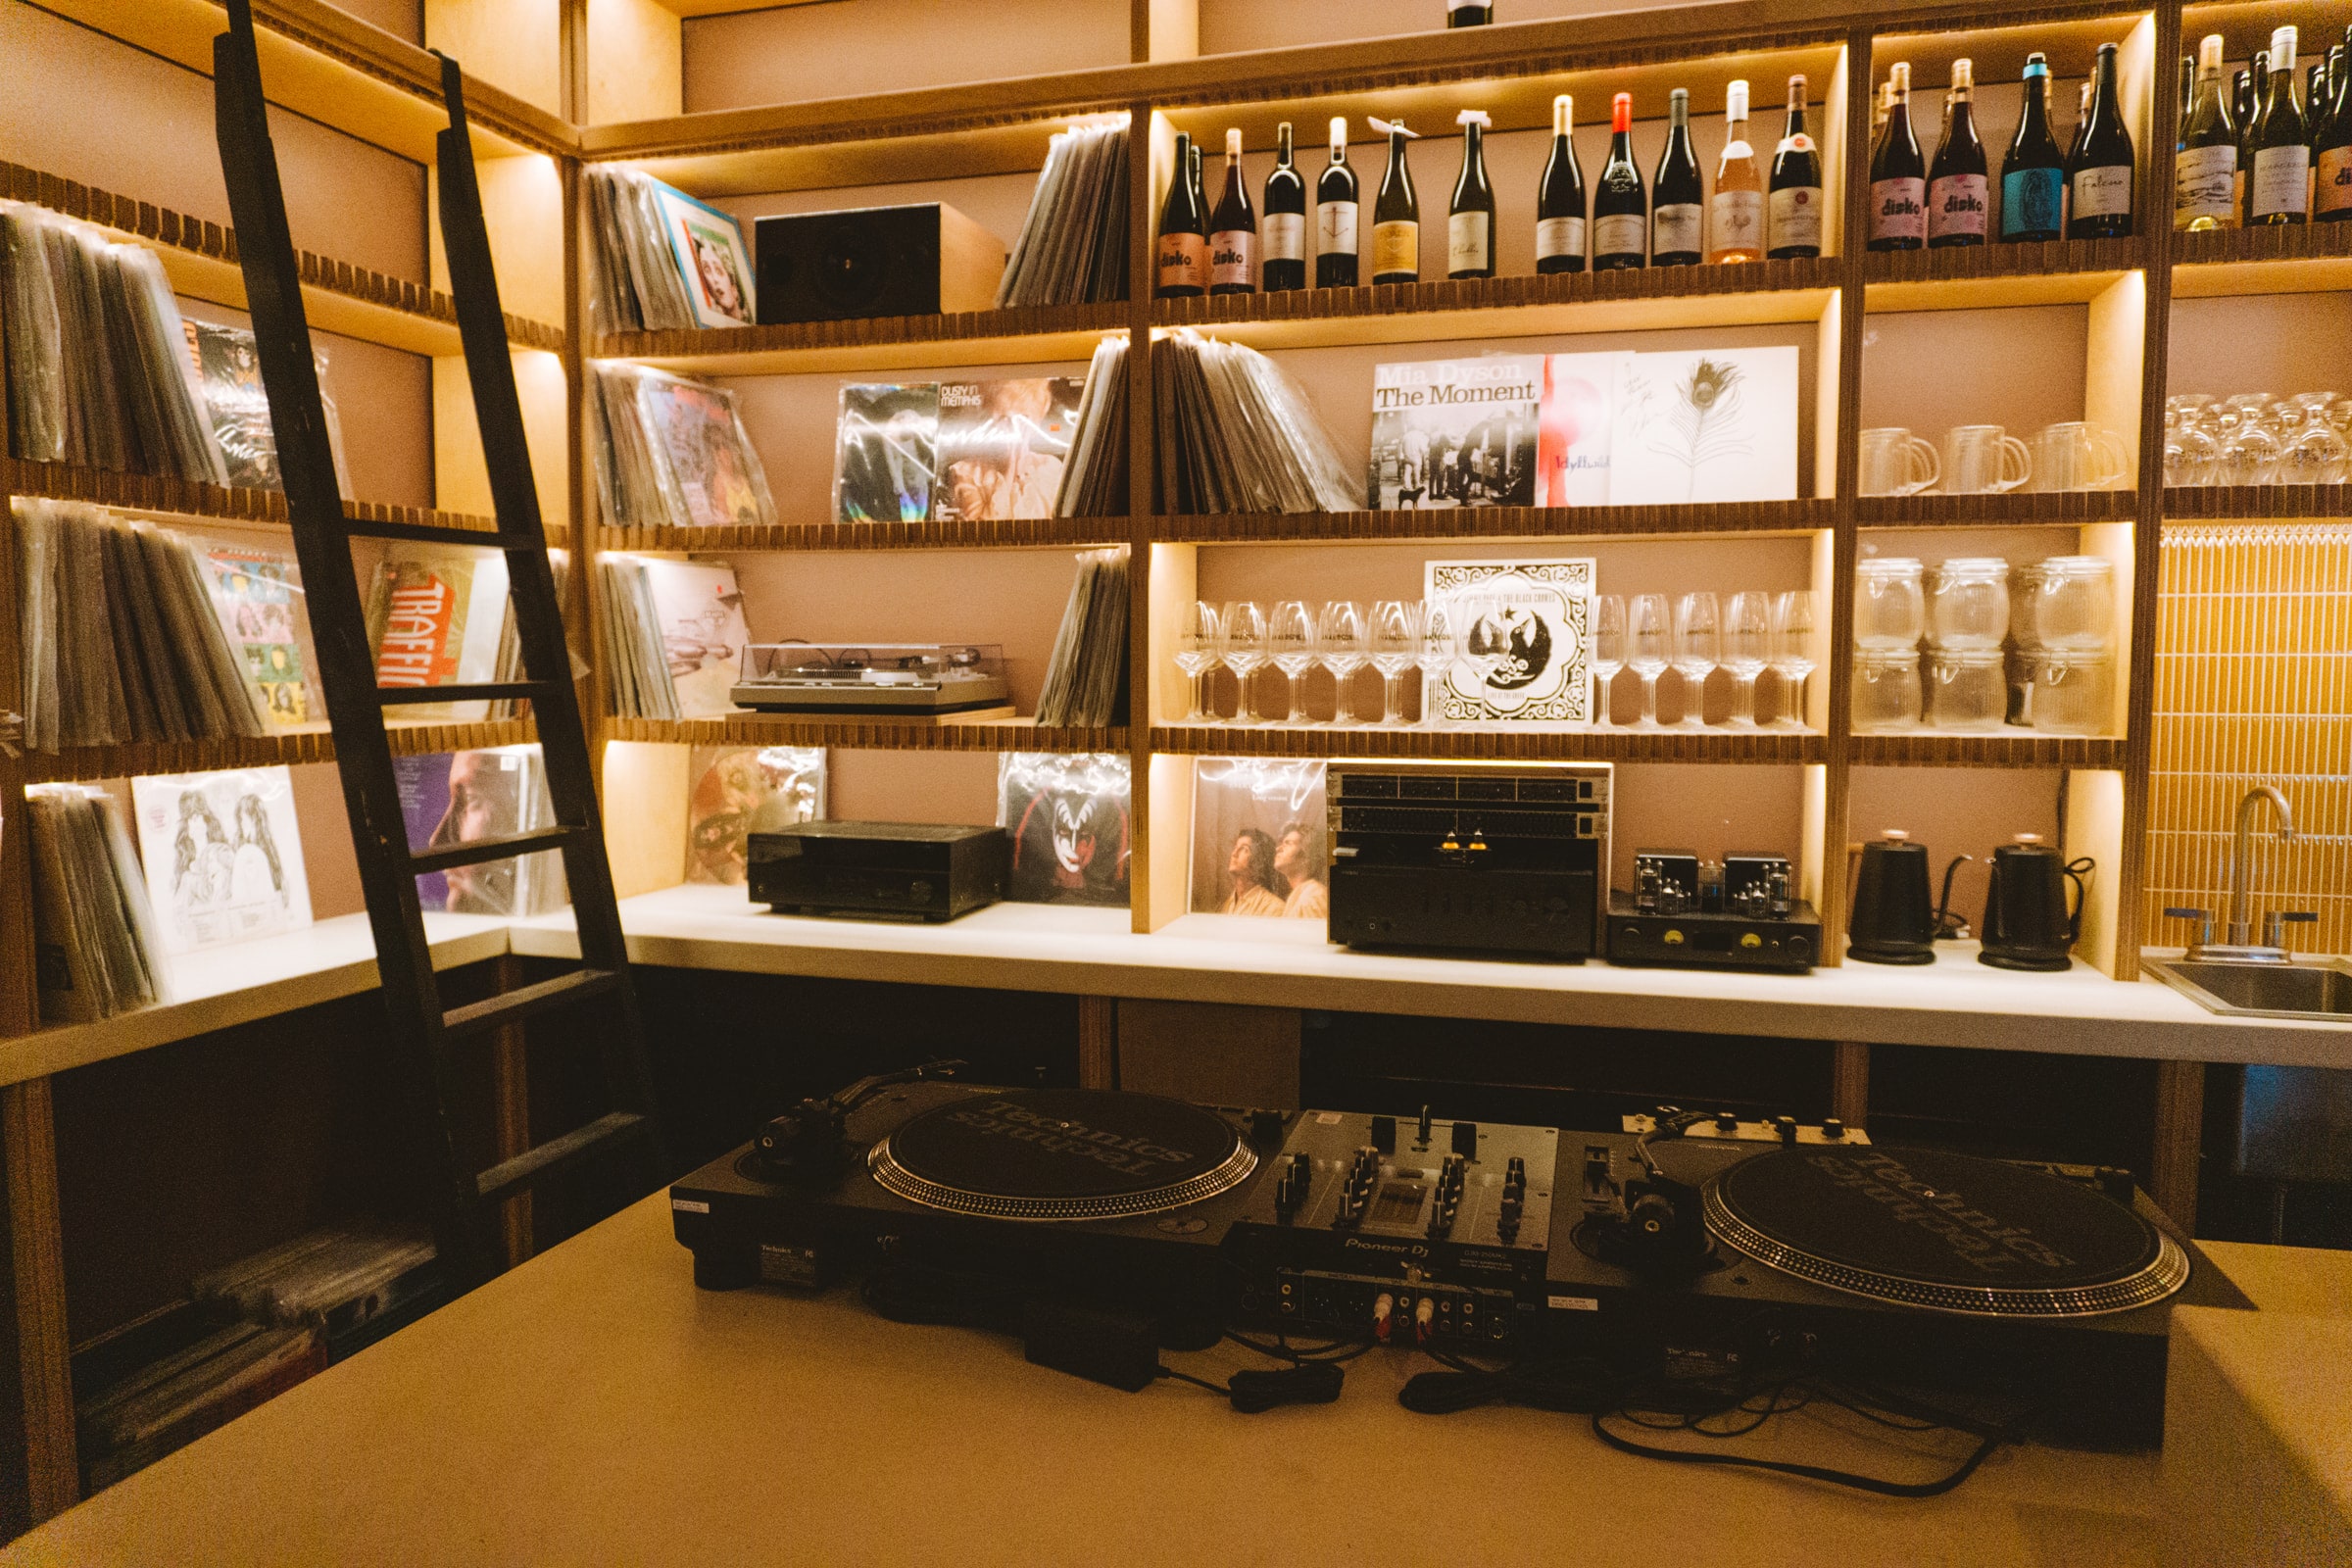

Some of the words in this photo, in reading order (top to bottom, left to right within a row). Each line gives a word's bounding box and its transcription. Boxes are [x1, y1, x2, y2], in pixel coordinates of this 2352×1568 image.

[1882, 197, 1921, 216] disko
[1944, 194, 1984, 213] disko
[1377, 366, 1429, 387] Mia
[1437, 364, 1523, 386] Dyson
[941, 385, 967, 397] DUSTY
[1377, 388, 1424, 408] The
[1429, 380, 1536, 405] Moment
[941, 395, 981, 408] MEMPHIS
[981, 1101, 1194, 1163] Technics
[1345, 1238, 1408, 1253] Pioneer
